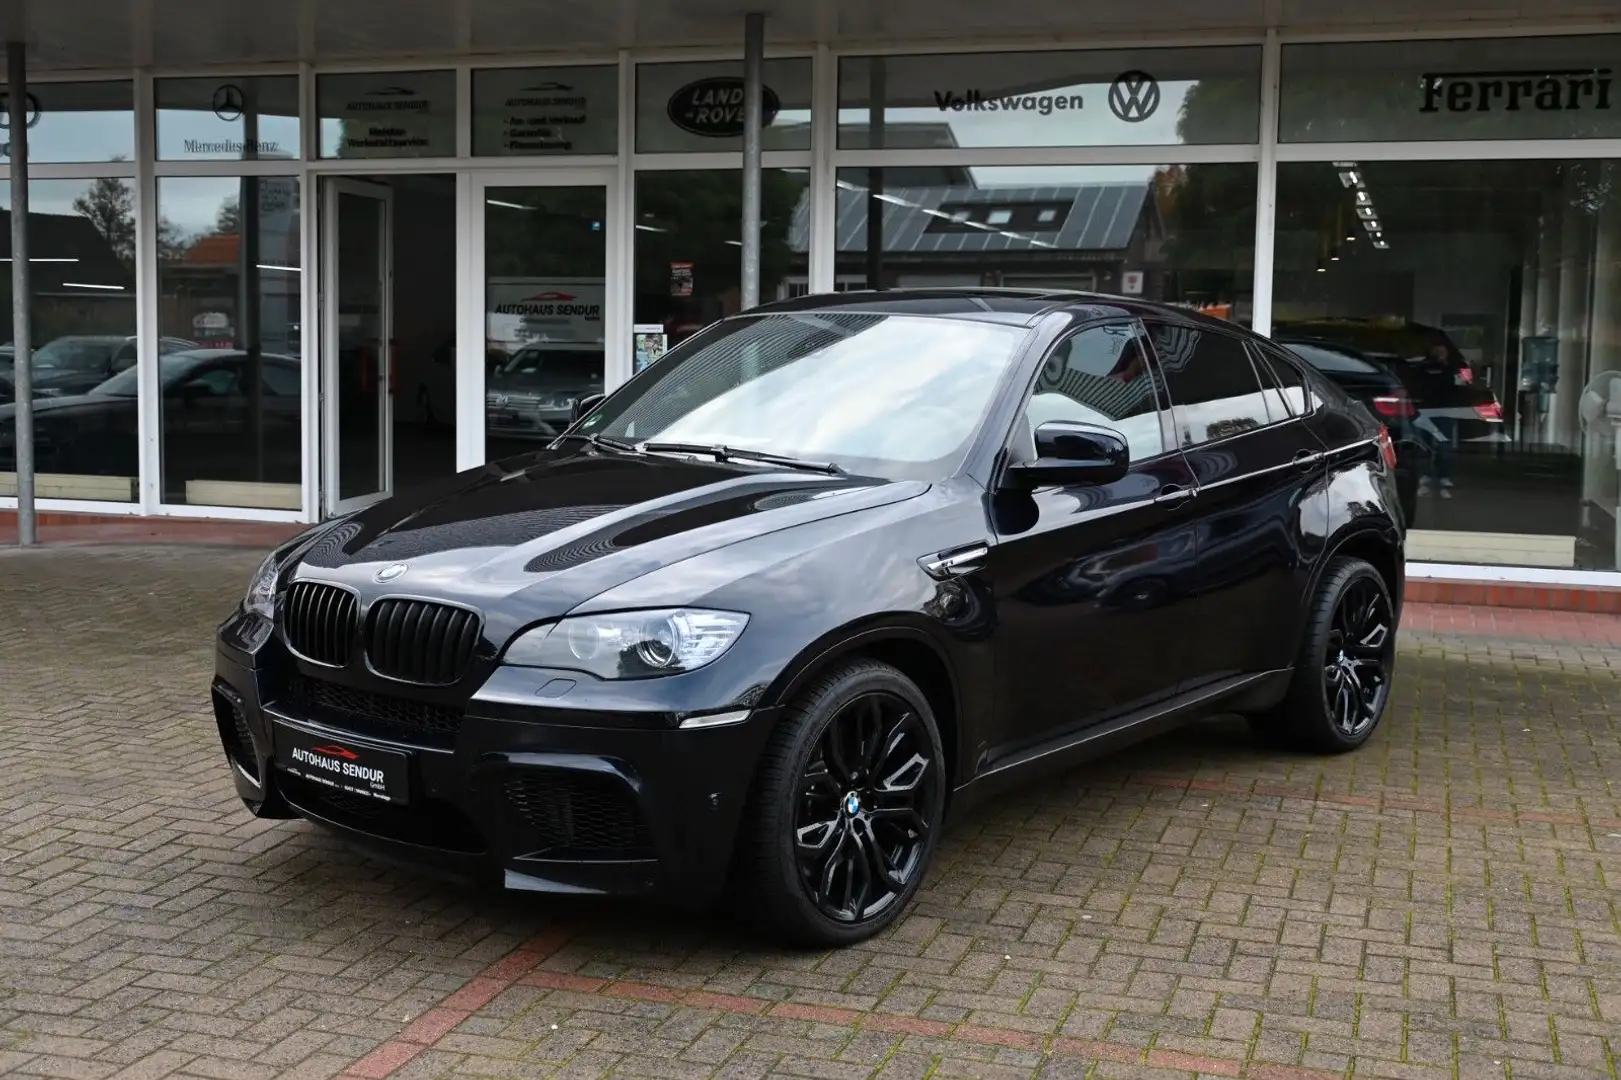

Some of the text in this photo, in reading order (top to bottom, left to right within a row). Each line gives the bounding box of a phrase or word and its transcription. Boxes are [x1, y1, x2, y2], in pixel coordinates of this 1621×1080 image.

[691, 88, 744, 105] LAND
[1419, 68, 1613, 112] Ferrari
[934, 90, 1083, 115] Volkswagen
[696, 107, 745, 123] ROVE
[494, 304, 600, 315] AUTOHAUS SENDUR
[292, 747, 384, 784] AUTOHAUS SENDUR
[369, 781, 386, 791] GmbH
